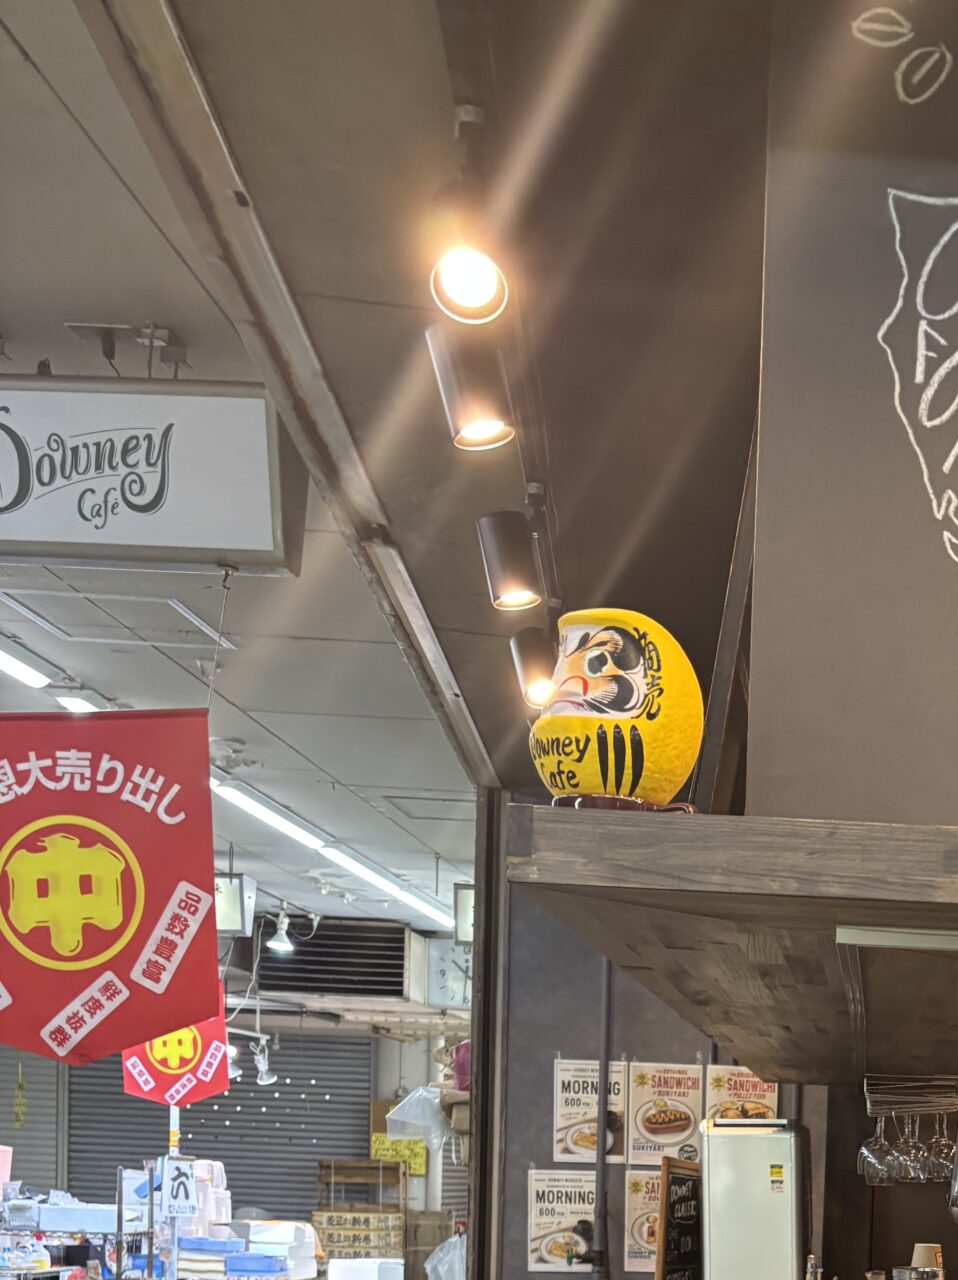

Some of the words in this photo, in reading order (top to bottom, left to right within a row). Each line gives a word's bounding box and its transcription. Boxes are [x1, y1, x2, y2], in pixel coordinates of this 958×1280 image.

[561, 1079, 621, 1096] MORNNG
[564, 1097, 582, 1107] 600
[535, 1189, 595, 1205] MORNING
[539, 1207, 556, 1217] 600
